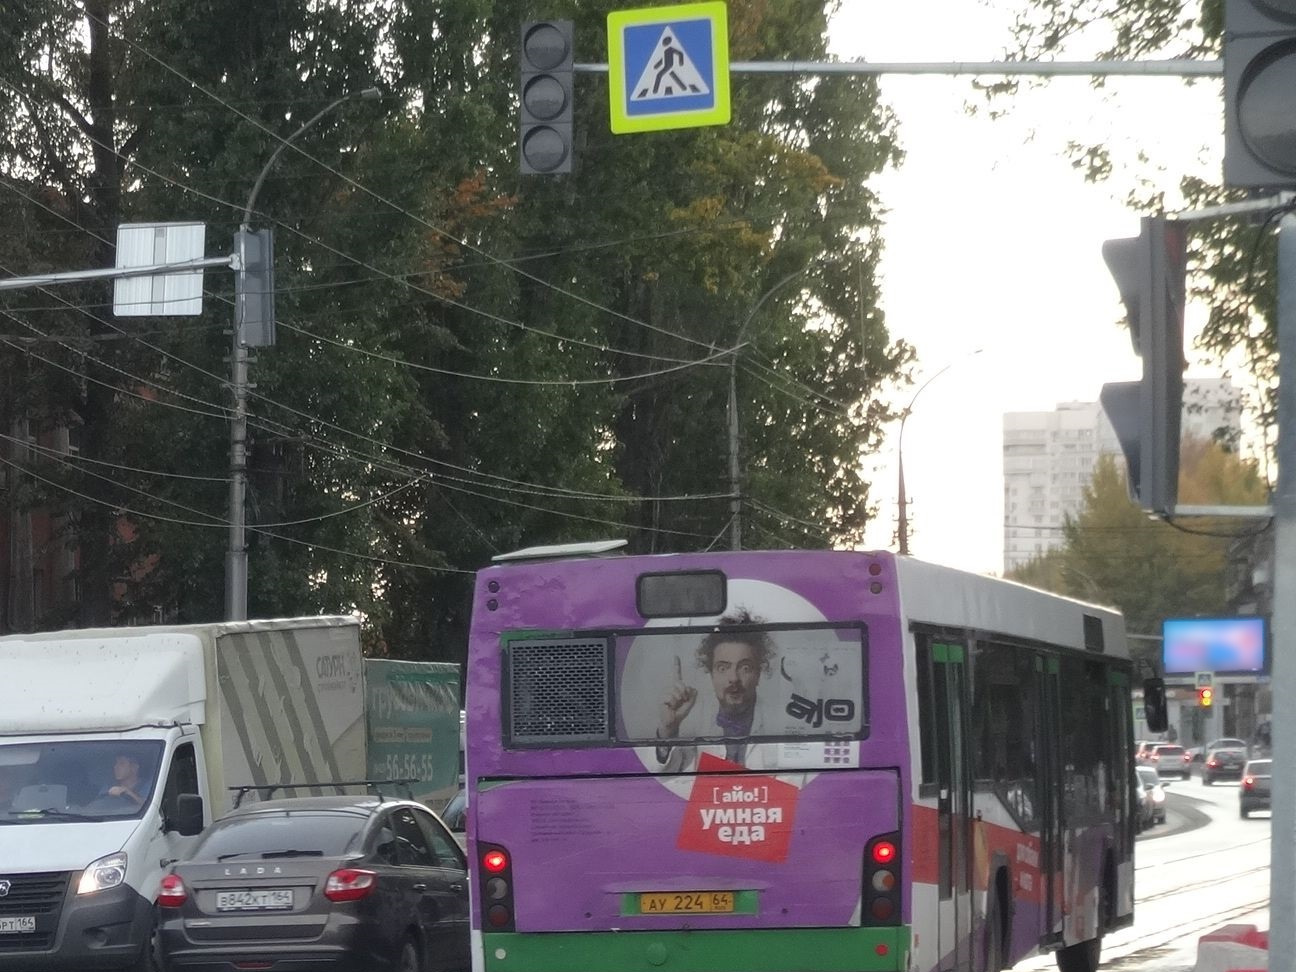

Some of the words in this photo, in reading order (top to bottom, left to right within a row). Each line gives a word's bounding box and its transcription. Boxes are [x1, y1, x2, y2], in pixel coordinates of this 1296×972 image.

[700, 807, 782, 830] умная
[718, 825, 765, 845] еда
[674, 894, 704, 910] 224
[712, 893, 728, 905] 64
